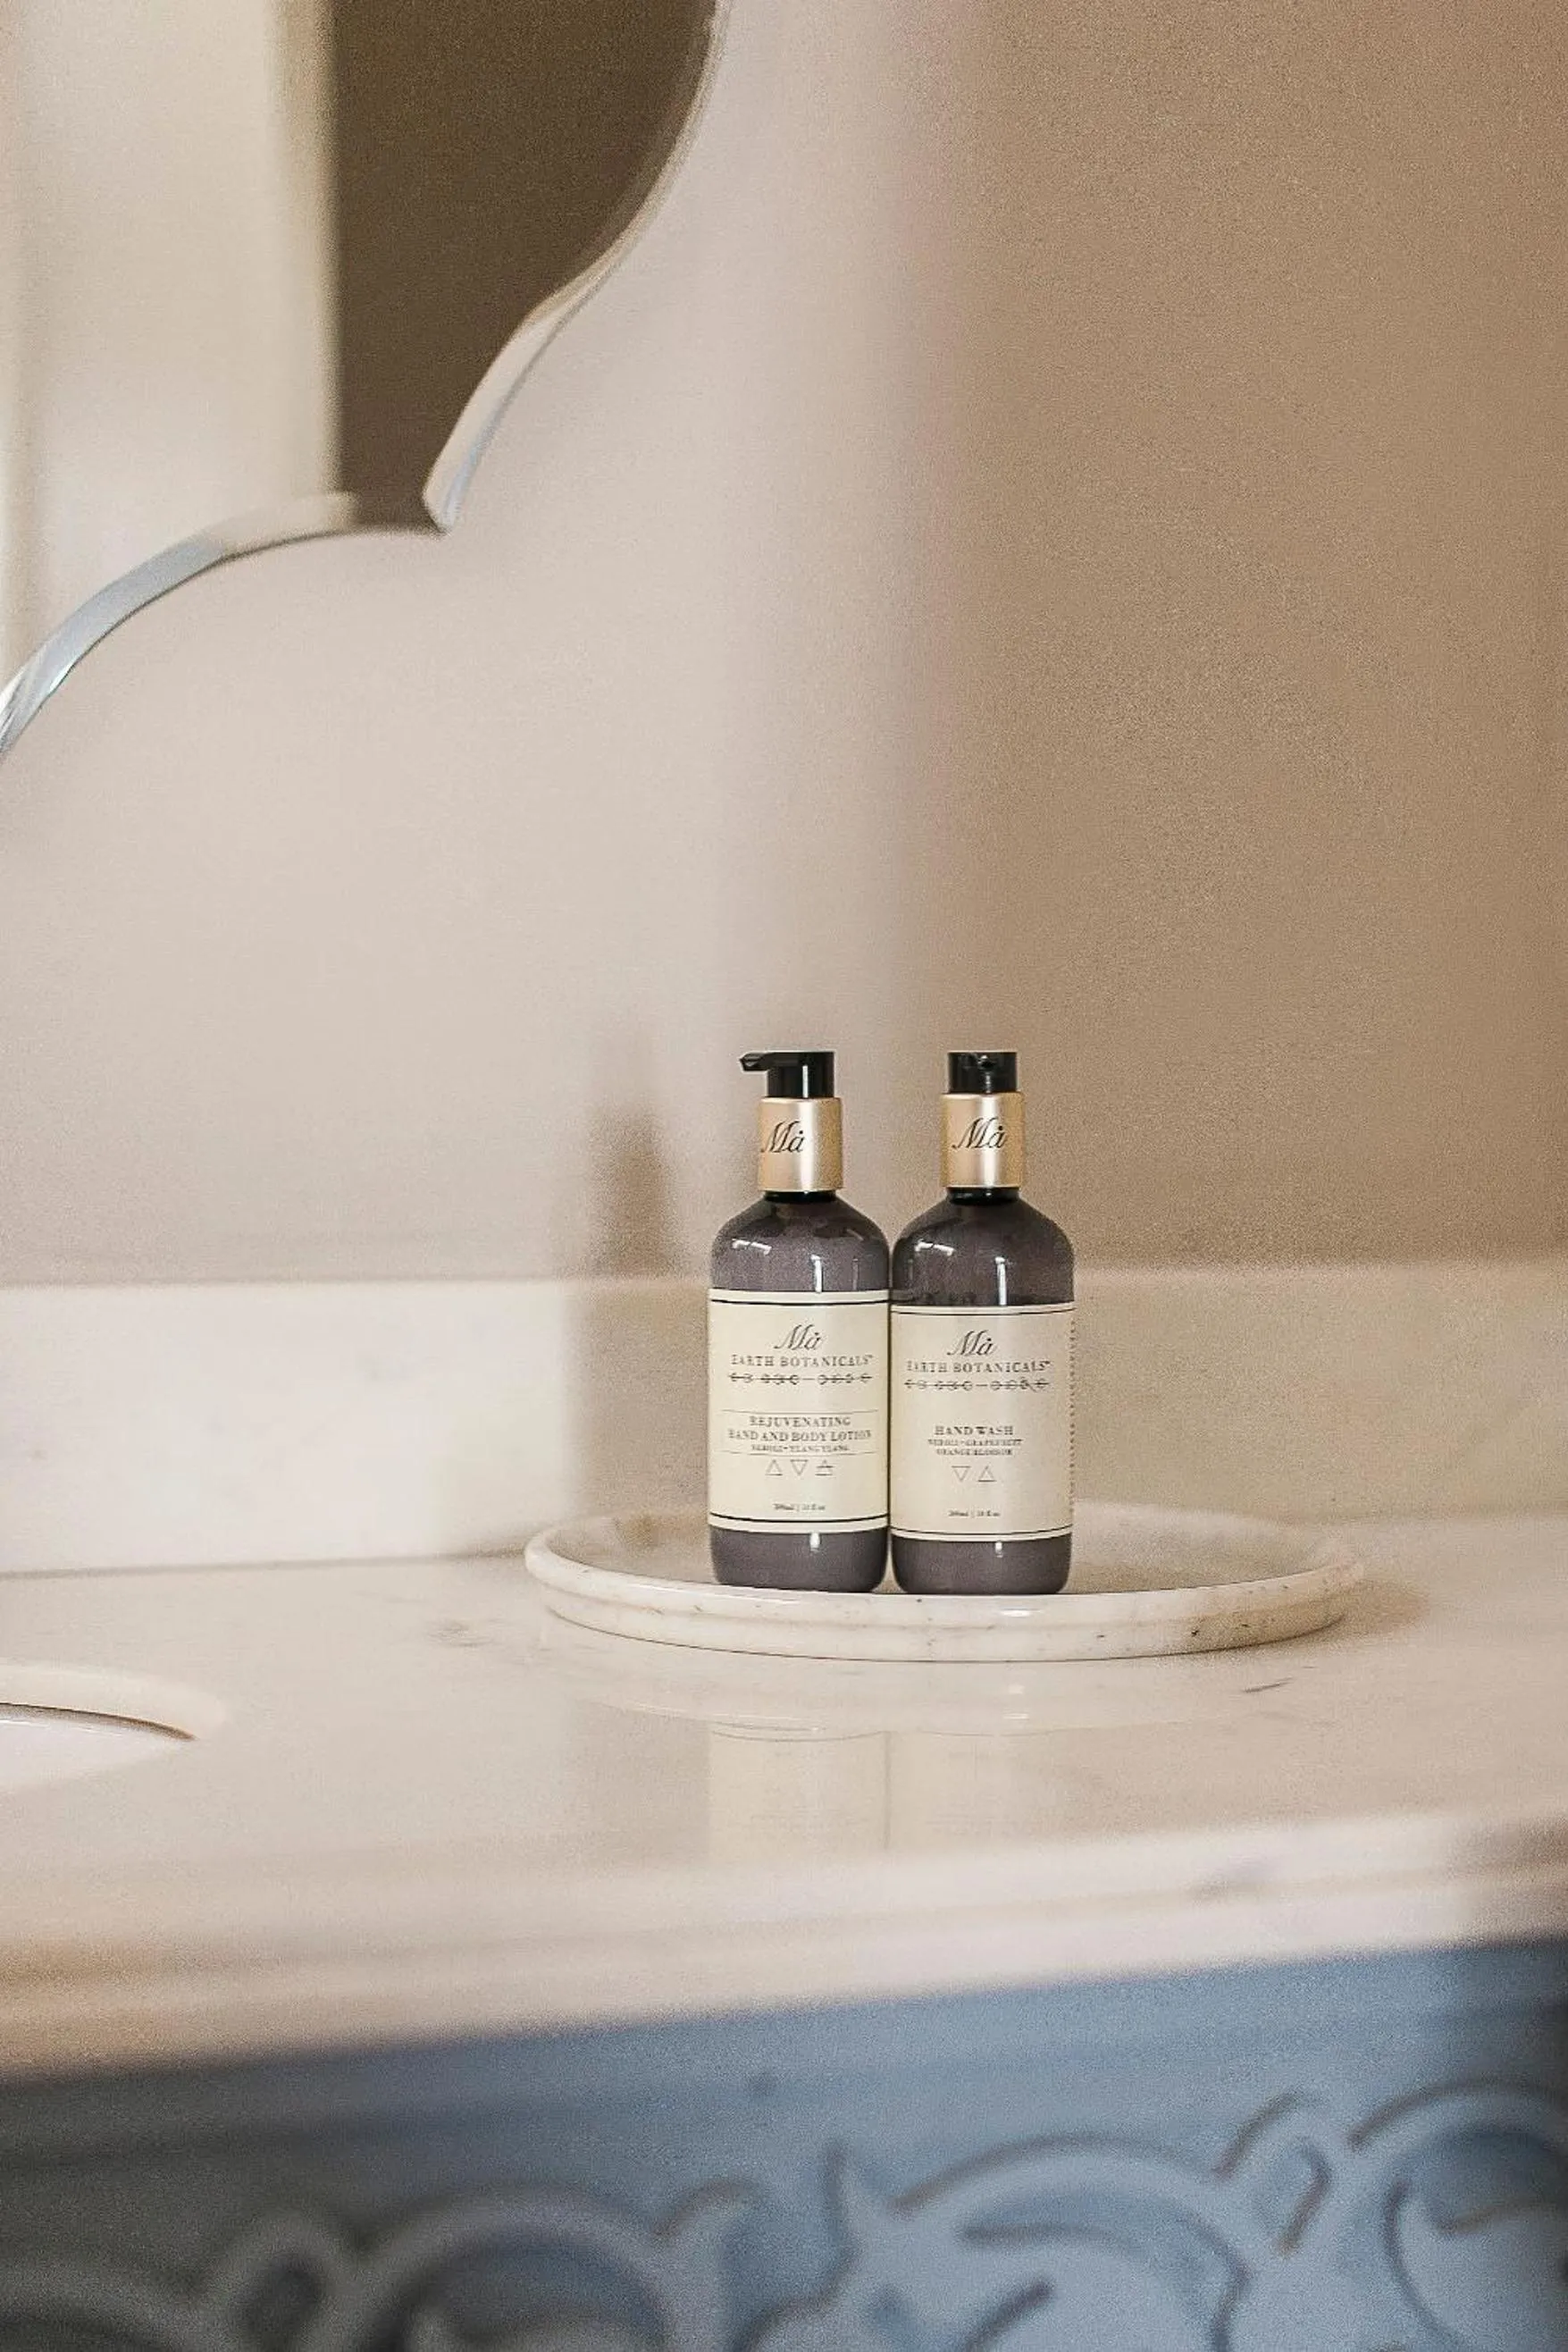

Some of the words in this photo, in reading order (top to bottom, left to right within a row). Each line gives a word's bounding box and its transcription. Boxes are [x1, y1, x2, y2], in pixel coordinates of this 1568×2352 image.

[731, 1354, 775, 1366] EARTH
[750, 1415, 851, 1427] REJUVENATING
[728, 1428, 759, 1441] HAND
[760, 1430, 789, 1441] AND
[791, 1430, 827, 1441] BODY
[831, 1429, 872, 1441] LOTION
[934, 1425, 974, 1435] HAND
[976, 1425, 1013, 1435] WASH
